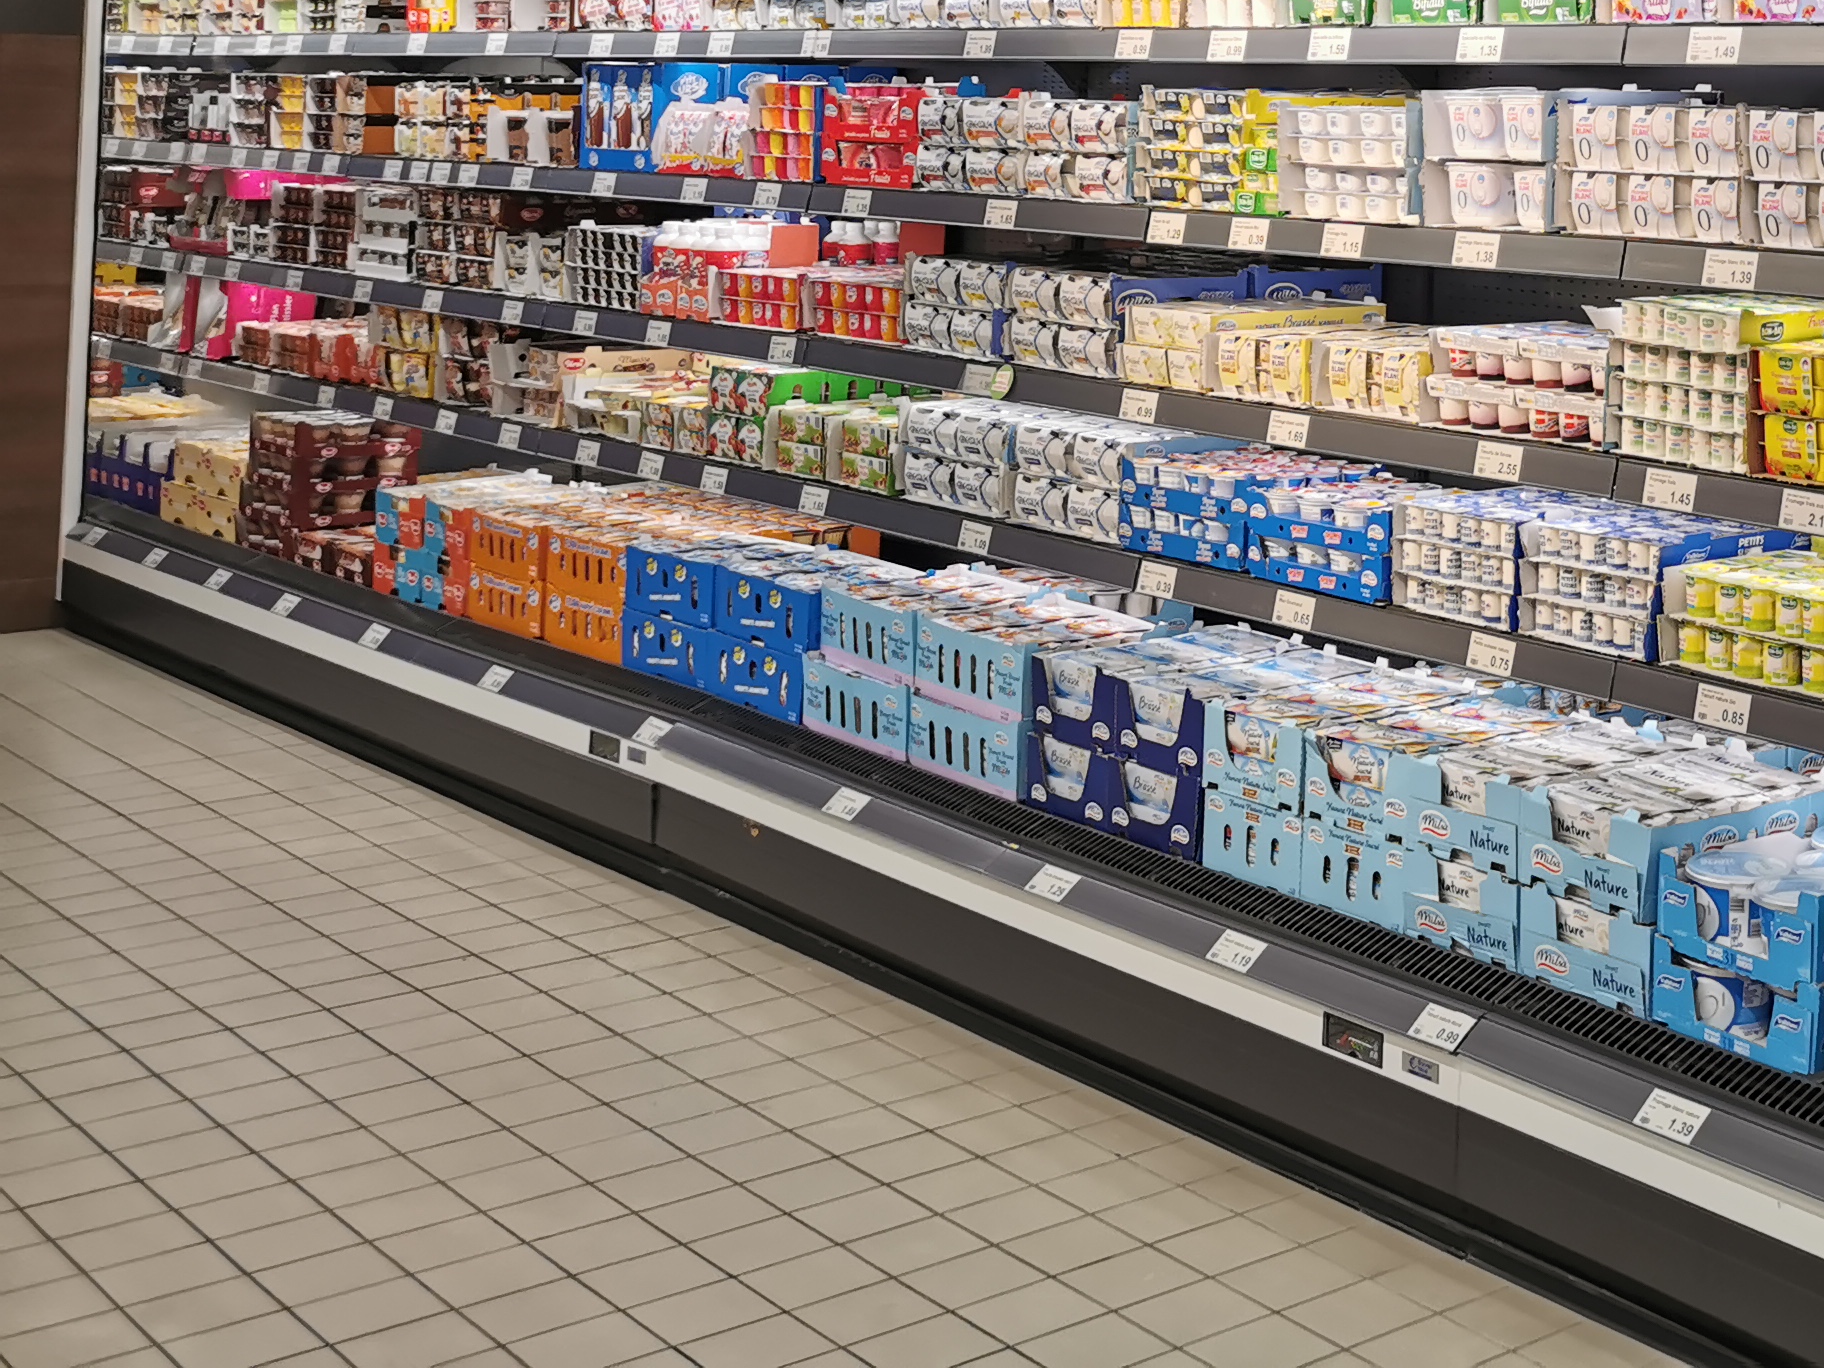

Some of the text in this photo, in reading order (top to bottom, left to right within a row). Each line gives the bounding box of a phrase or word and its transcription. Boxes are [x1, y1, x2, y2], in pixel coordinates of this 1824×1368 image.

[1132, 44, 1147, 55] 0.99
[1480, 45, 1498, 57] 1.35
[1714, 45, 1736, 59] 1.49
[1166, 229, 1181, 239] 1.29
[1248, 235, 1264, 245] 0.39
[1342, 241, 1359, 253] 1.15
[1475, 251, 1493, 263] 1.38
[1730, 270, 1752, 284] 1.39
[1137, 406, 1153, 418] 0.99
[1288, 430, 1304, 443] 1.69
[1497, 462, 1517, 476] 2.55
[1670, 490, 1691, 506] 1.45
[1156, 581, 1172, 593] 0.39
[1293, 611, 1310, 626] 0.65
[1490, 656, 1510, 671] 0.75
[1722, 708, 1744, 726] 0.85
[1469, 829, 1510, 856] Nature
[1047, 883, 1068, 897] 1.29
[1584, 869, 1629, 899] Nature
[1466, 927, 1507, 952] Nature
[1229, 952, 1252, 967] 1.19
[1592, 967, 1636, 998] Nature
[1435, 1028, 1460, 1044] 0.99
[1668, 1118, 1694, 1137] 1.39
